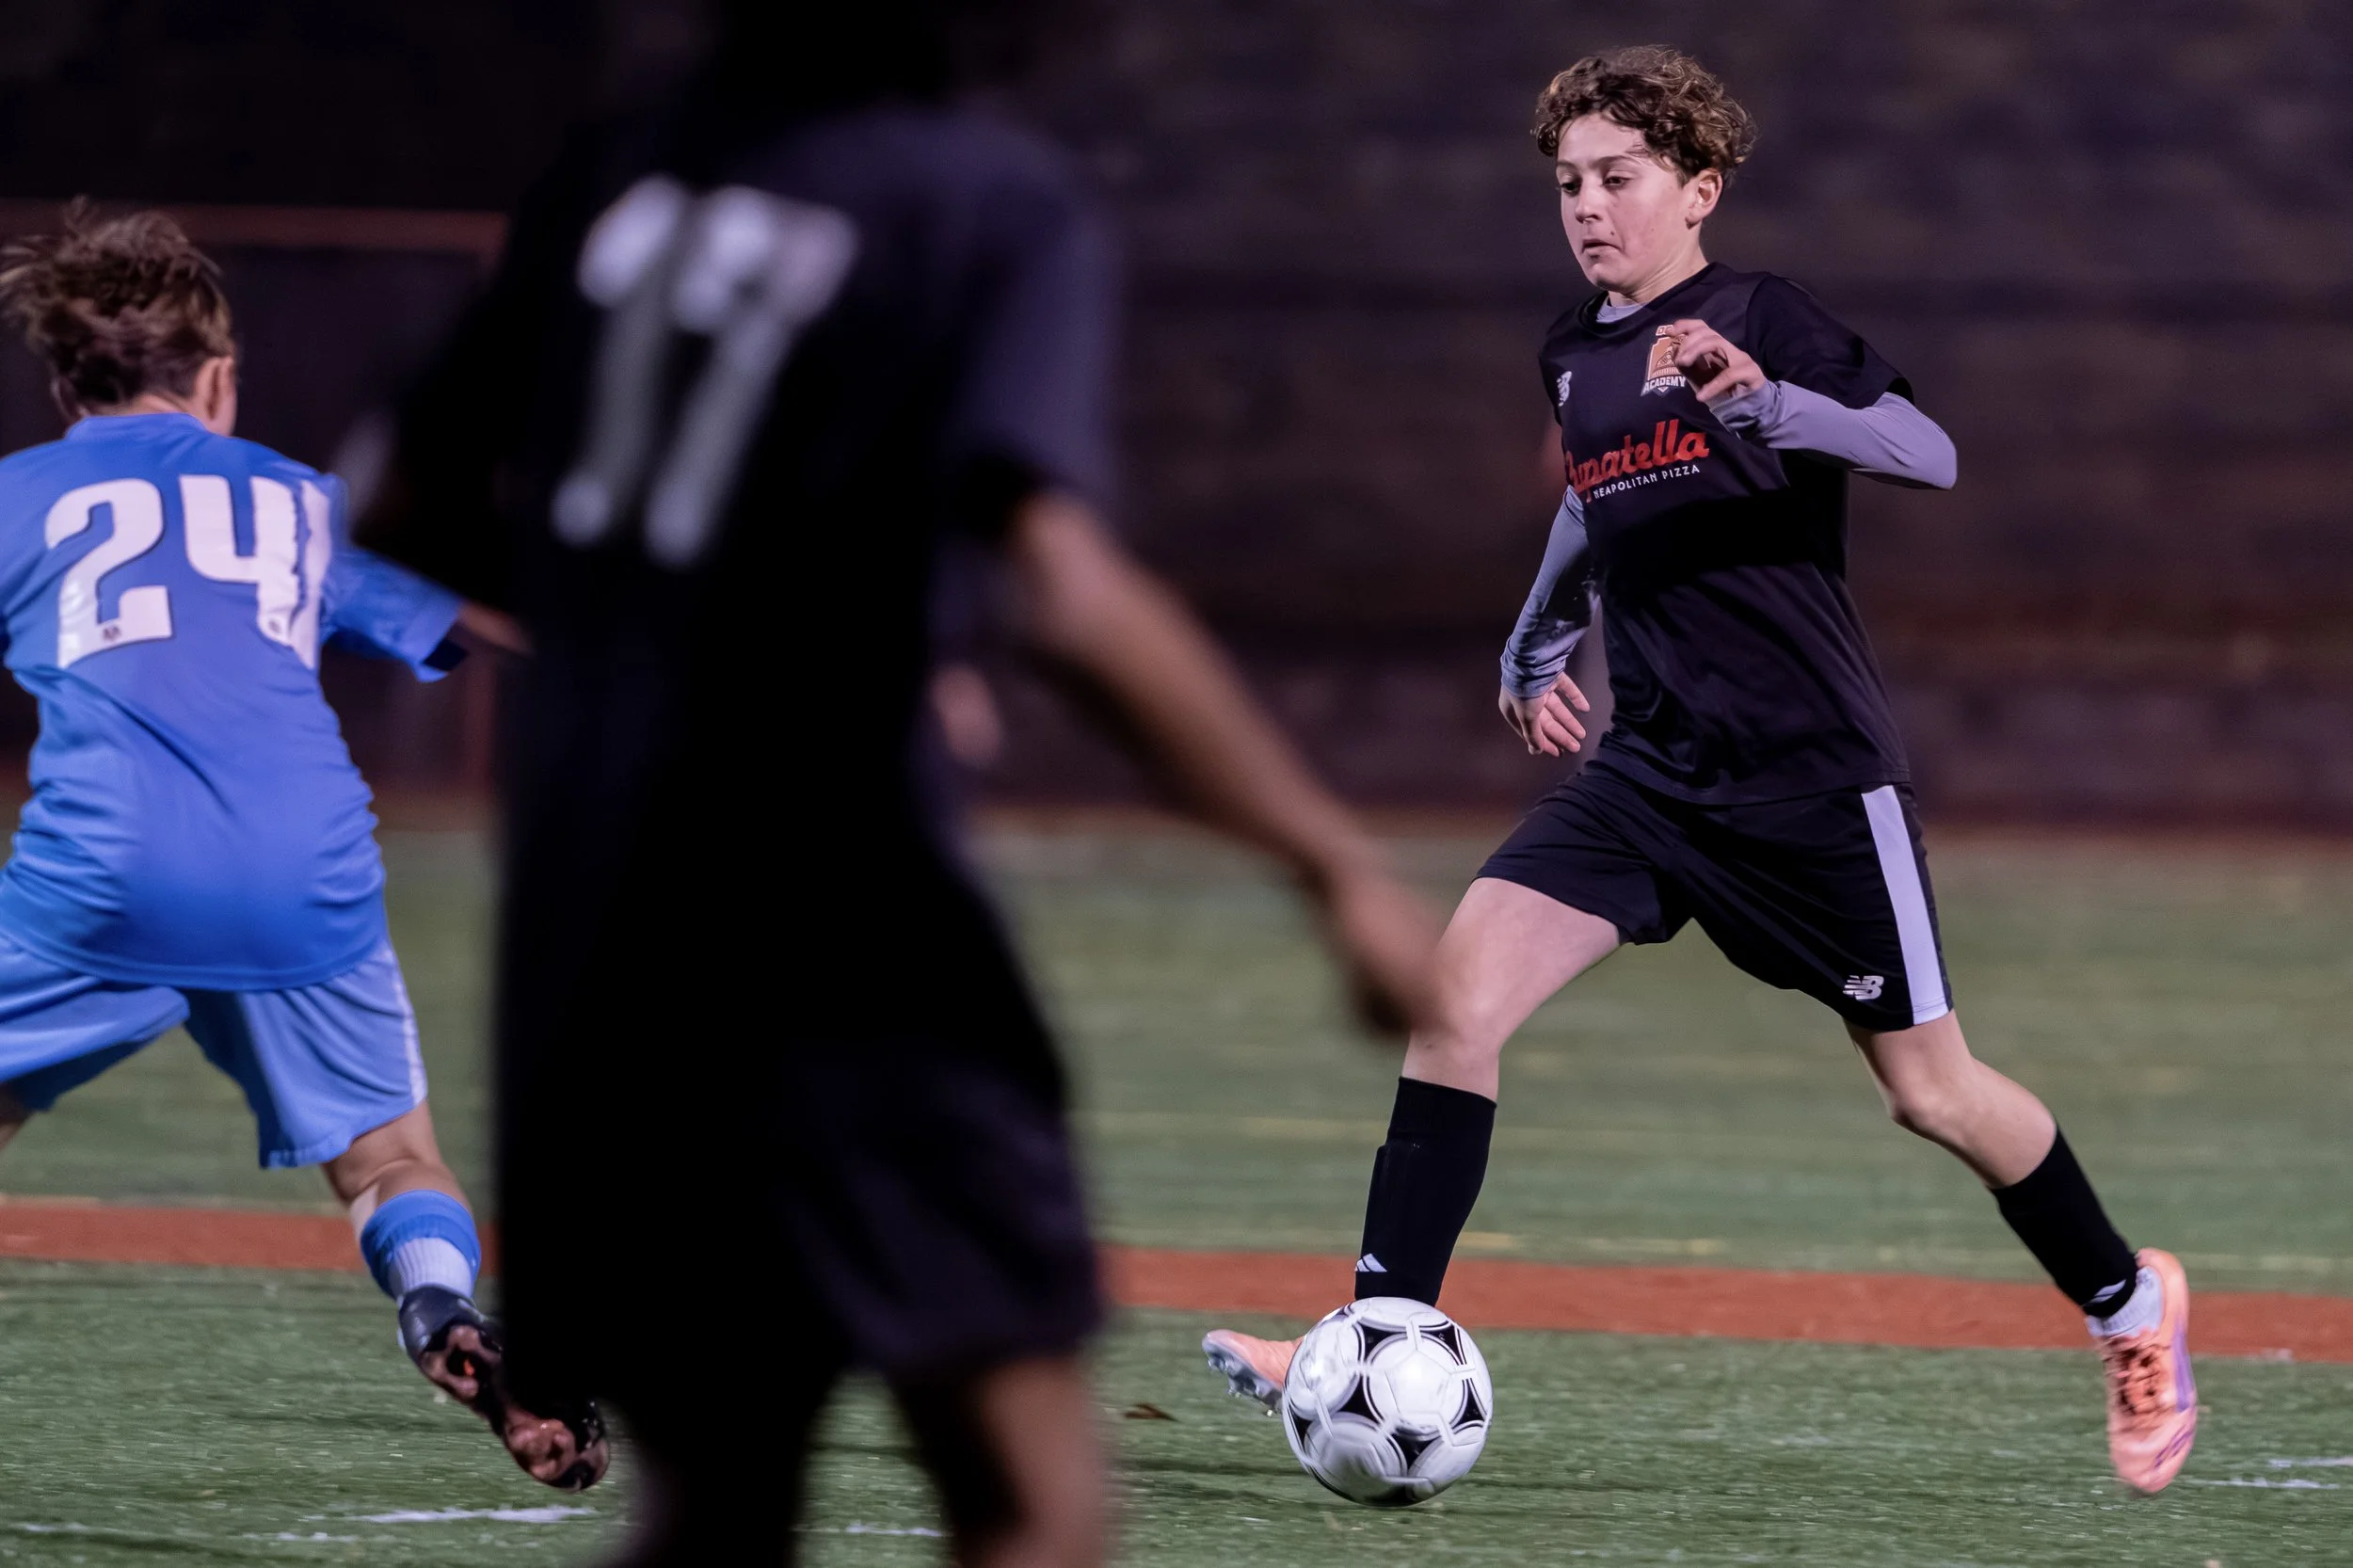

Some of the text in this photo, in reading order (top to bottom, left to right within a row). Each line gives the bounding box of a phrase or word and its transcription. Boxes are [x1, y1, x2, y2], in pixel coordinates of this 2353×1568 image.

[1641, 376, 1686, 395] ACADEMY
[1593, 464, 1700, 499] NEAPOLITAN PIZZA
[44, 474, 331, 669] 24
